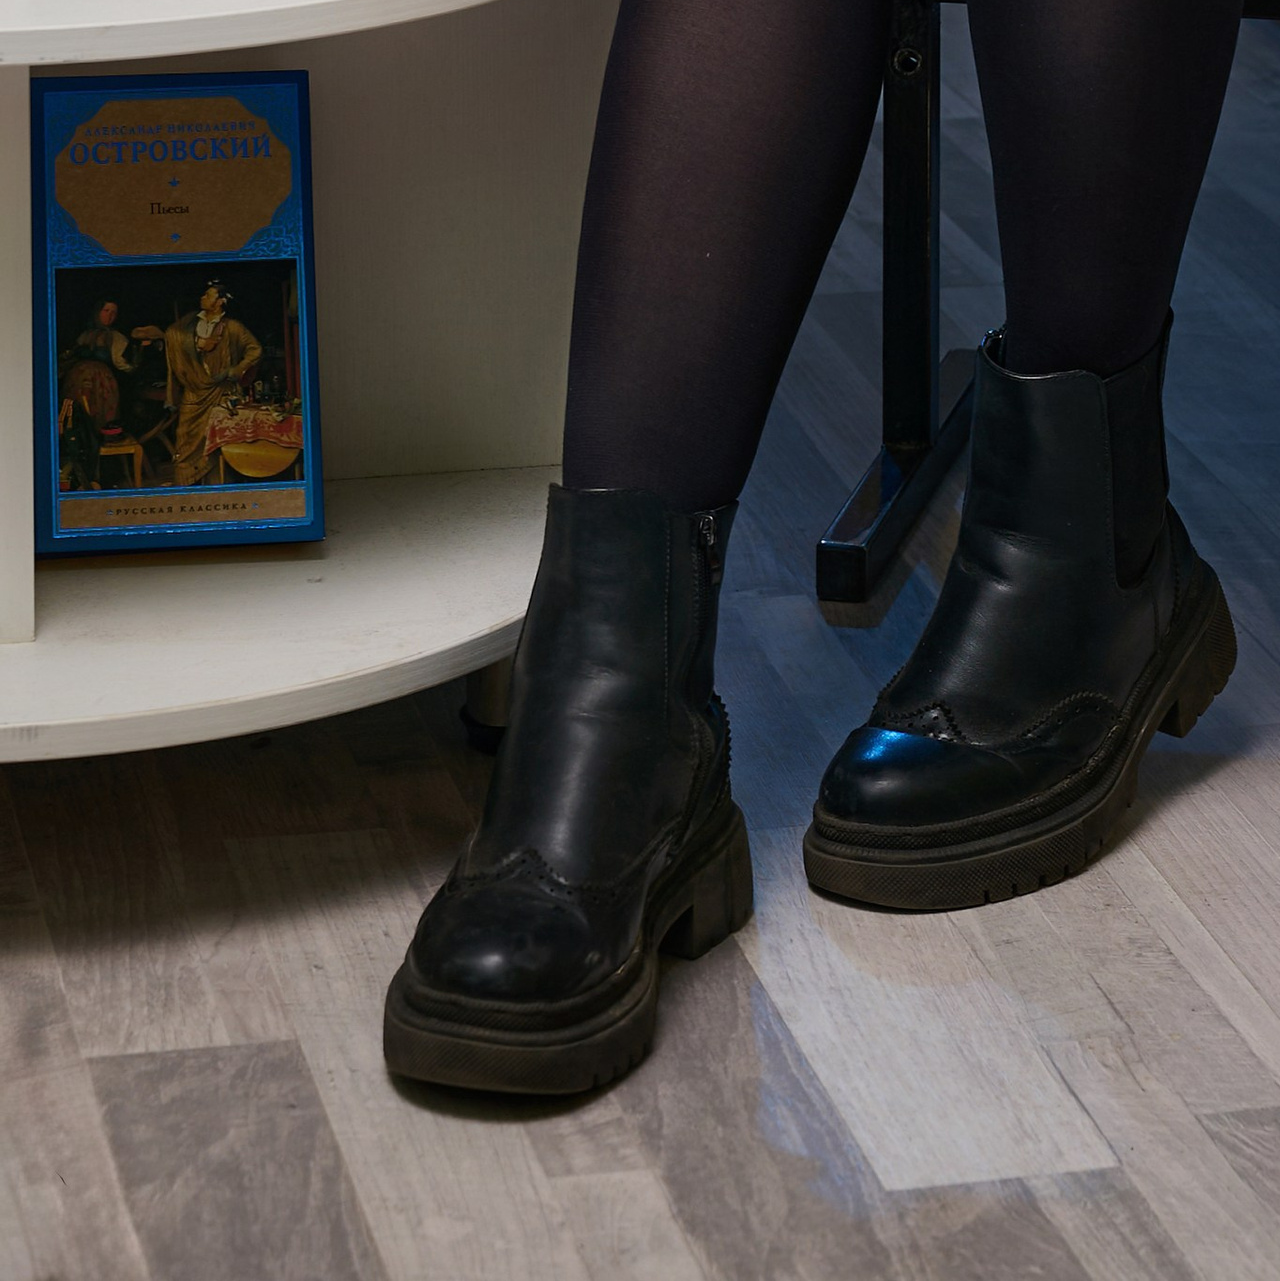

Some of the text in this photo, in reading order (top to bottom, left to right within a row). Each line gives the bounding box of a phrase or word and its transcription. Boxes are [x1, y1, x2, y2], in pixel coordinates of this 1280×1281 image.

[85, 120, 256, 137] АЛЕКСАНДР НИКОЛАЕВИЧ
[69, 133, 272, 166] ОСТРОВСКИЙ
[149, 202, 190, 216] Пьесы
[116, 502, 248, 516] РУССКАЯ КЛАССИКА
